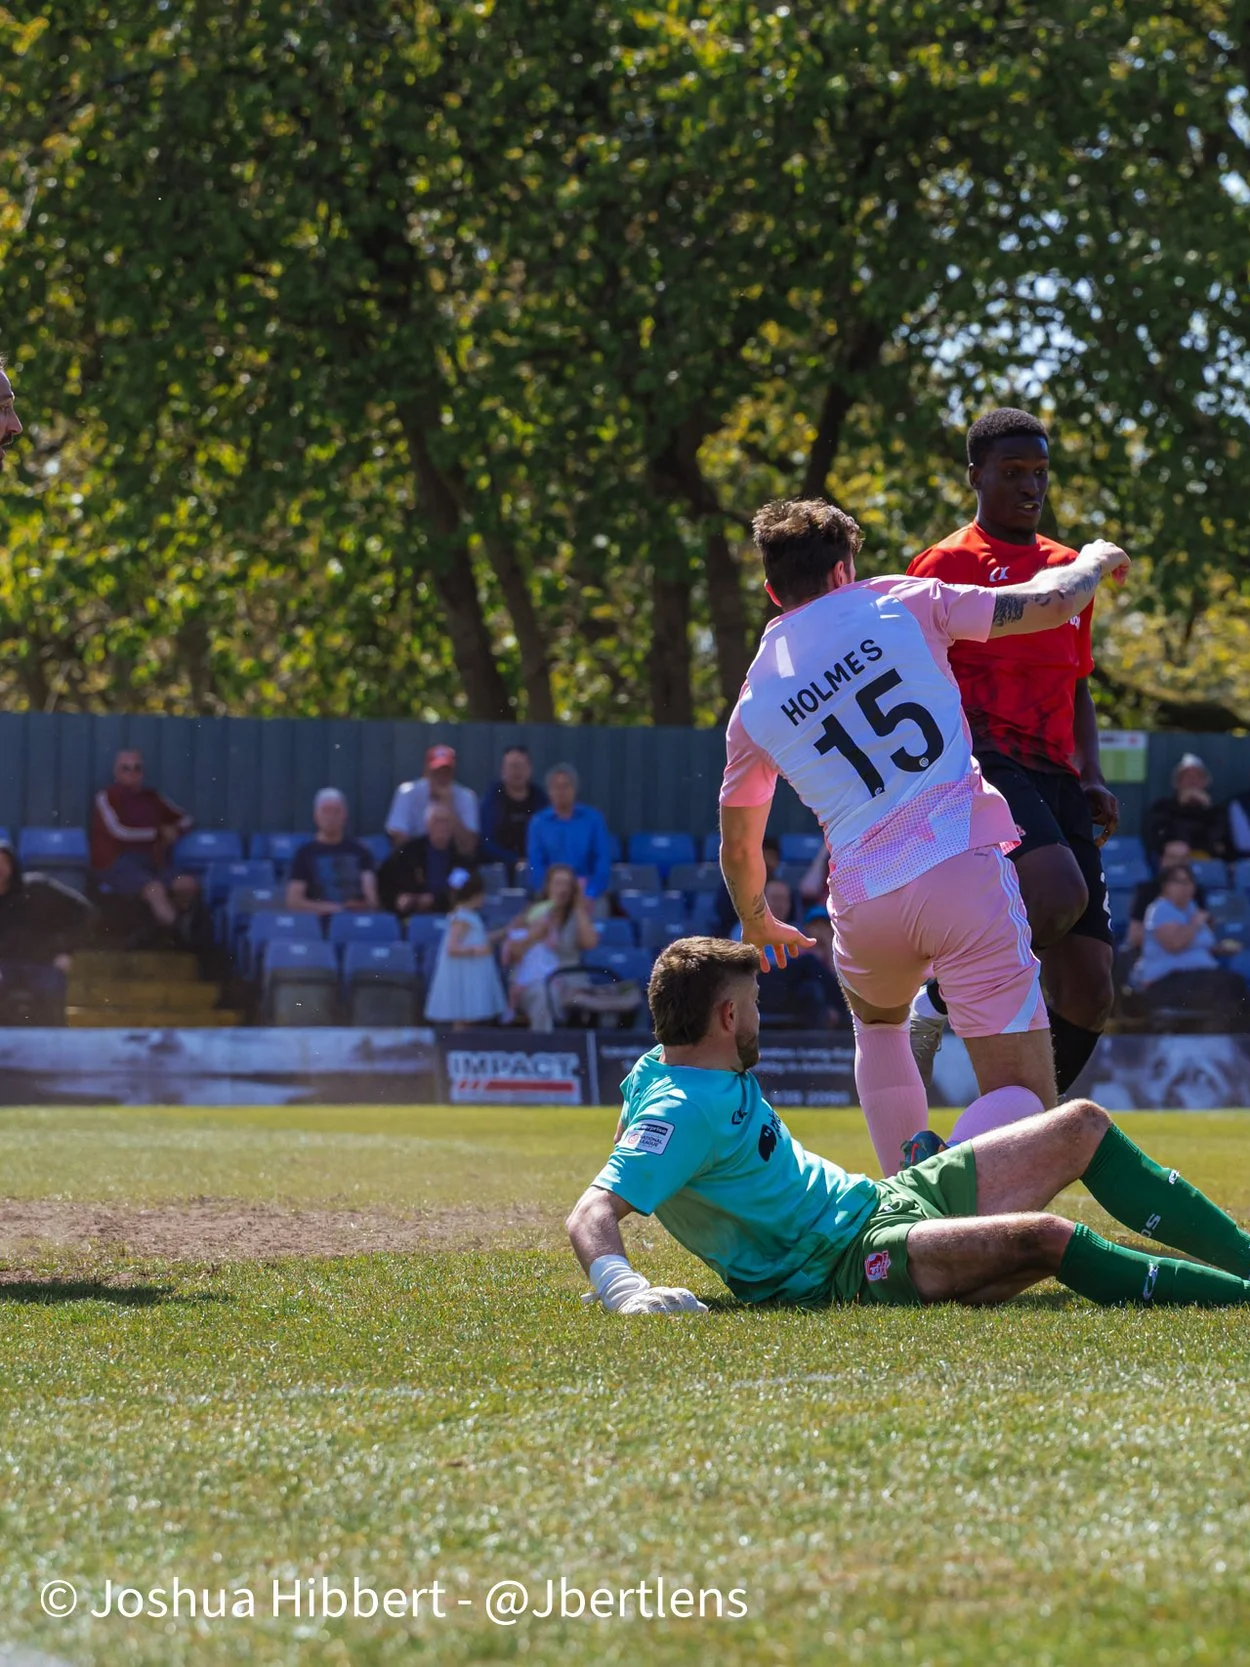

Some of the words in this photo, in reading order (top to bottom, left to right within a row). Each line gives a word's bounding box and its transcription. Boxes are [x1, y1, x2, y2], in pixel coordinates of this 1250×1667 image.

[780, 639, 883, 727] HOLMES
[813, 668, 944, 798] 15
[449, 1051, 579, 1078] IMPACT
